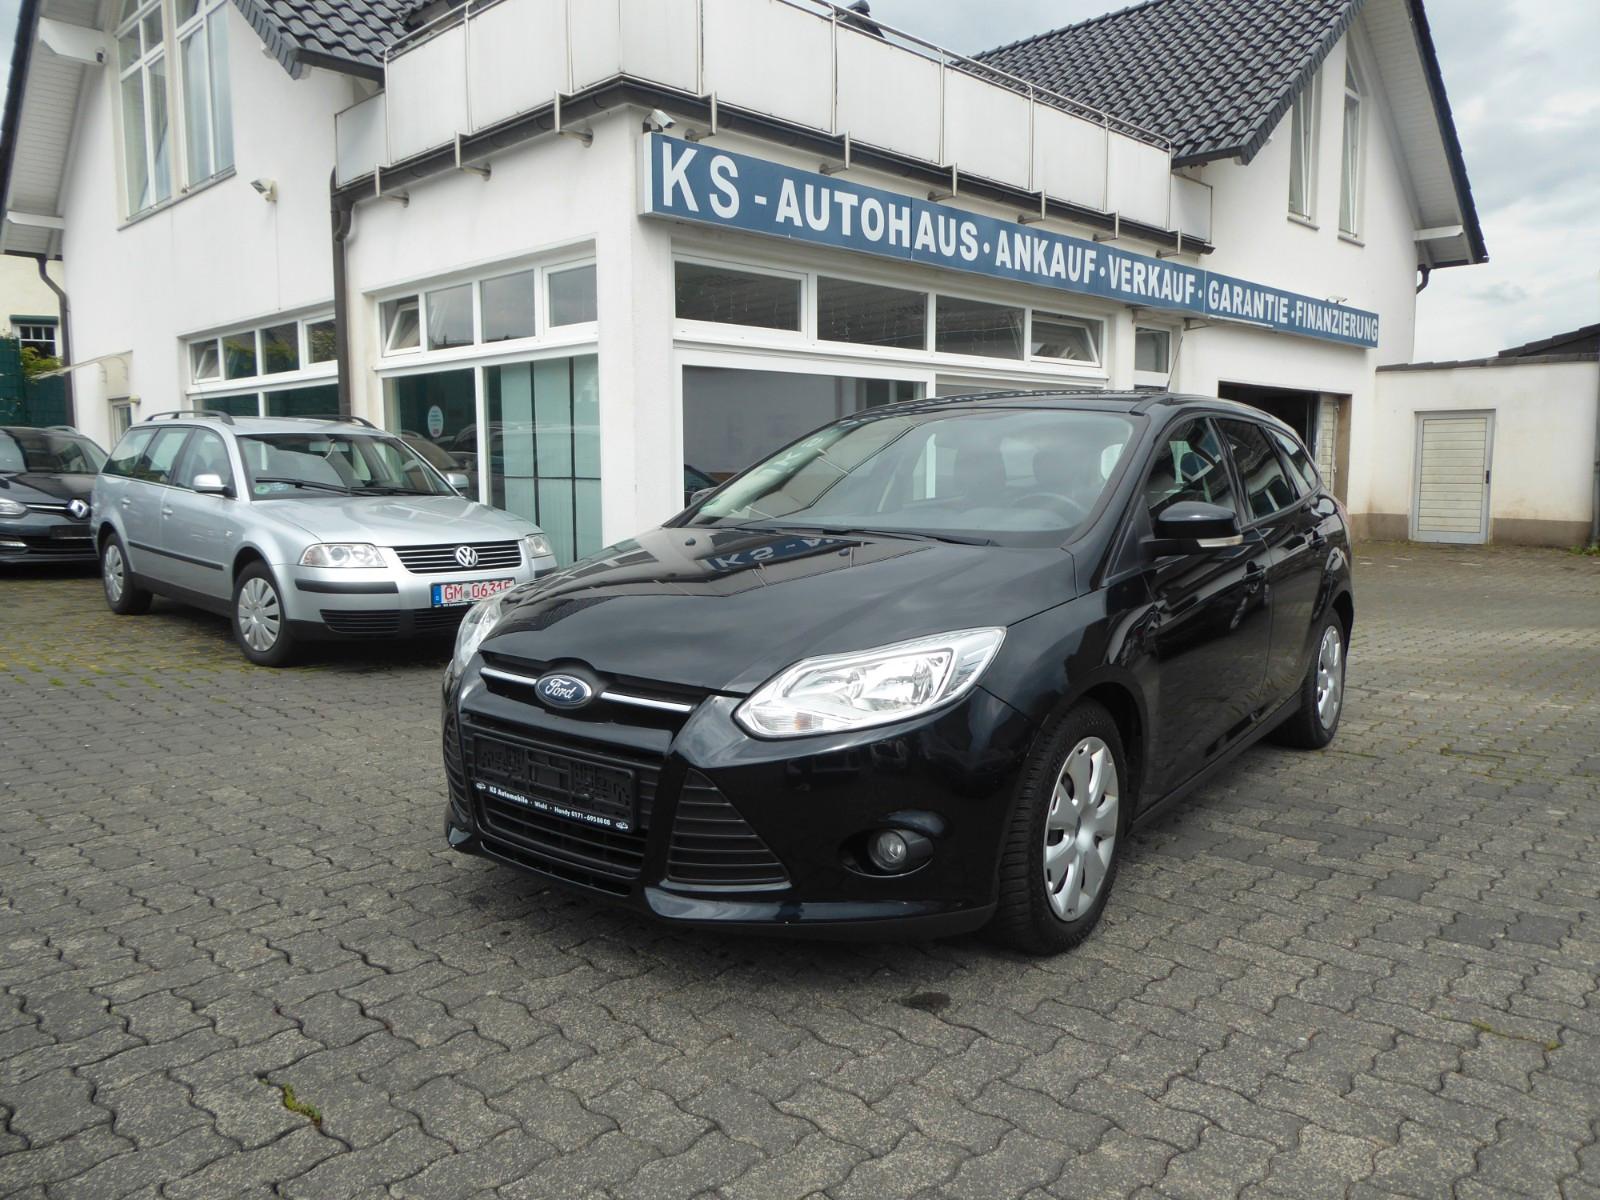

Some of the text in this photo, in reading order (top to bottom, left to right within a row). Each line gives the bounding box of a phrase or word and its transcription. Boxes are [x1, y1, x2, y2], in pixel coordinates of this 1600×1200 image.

[776, 178, 978, 261] AUTOHAUS
[995, 230, 1096, 284] ANKAUF
[1108, 254, 1195, 304] VERKAUF
[1208, 280, 1288, 323] GARANTIE
[1295, 300, 1378, 342] FINANZIERUNG
[444, 584, 462, 600] GM
[545, 678, 577, 699] Ford
[498, 788, 529, 804] Automobile
